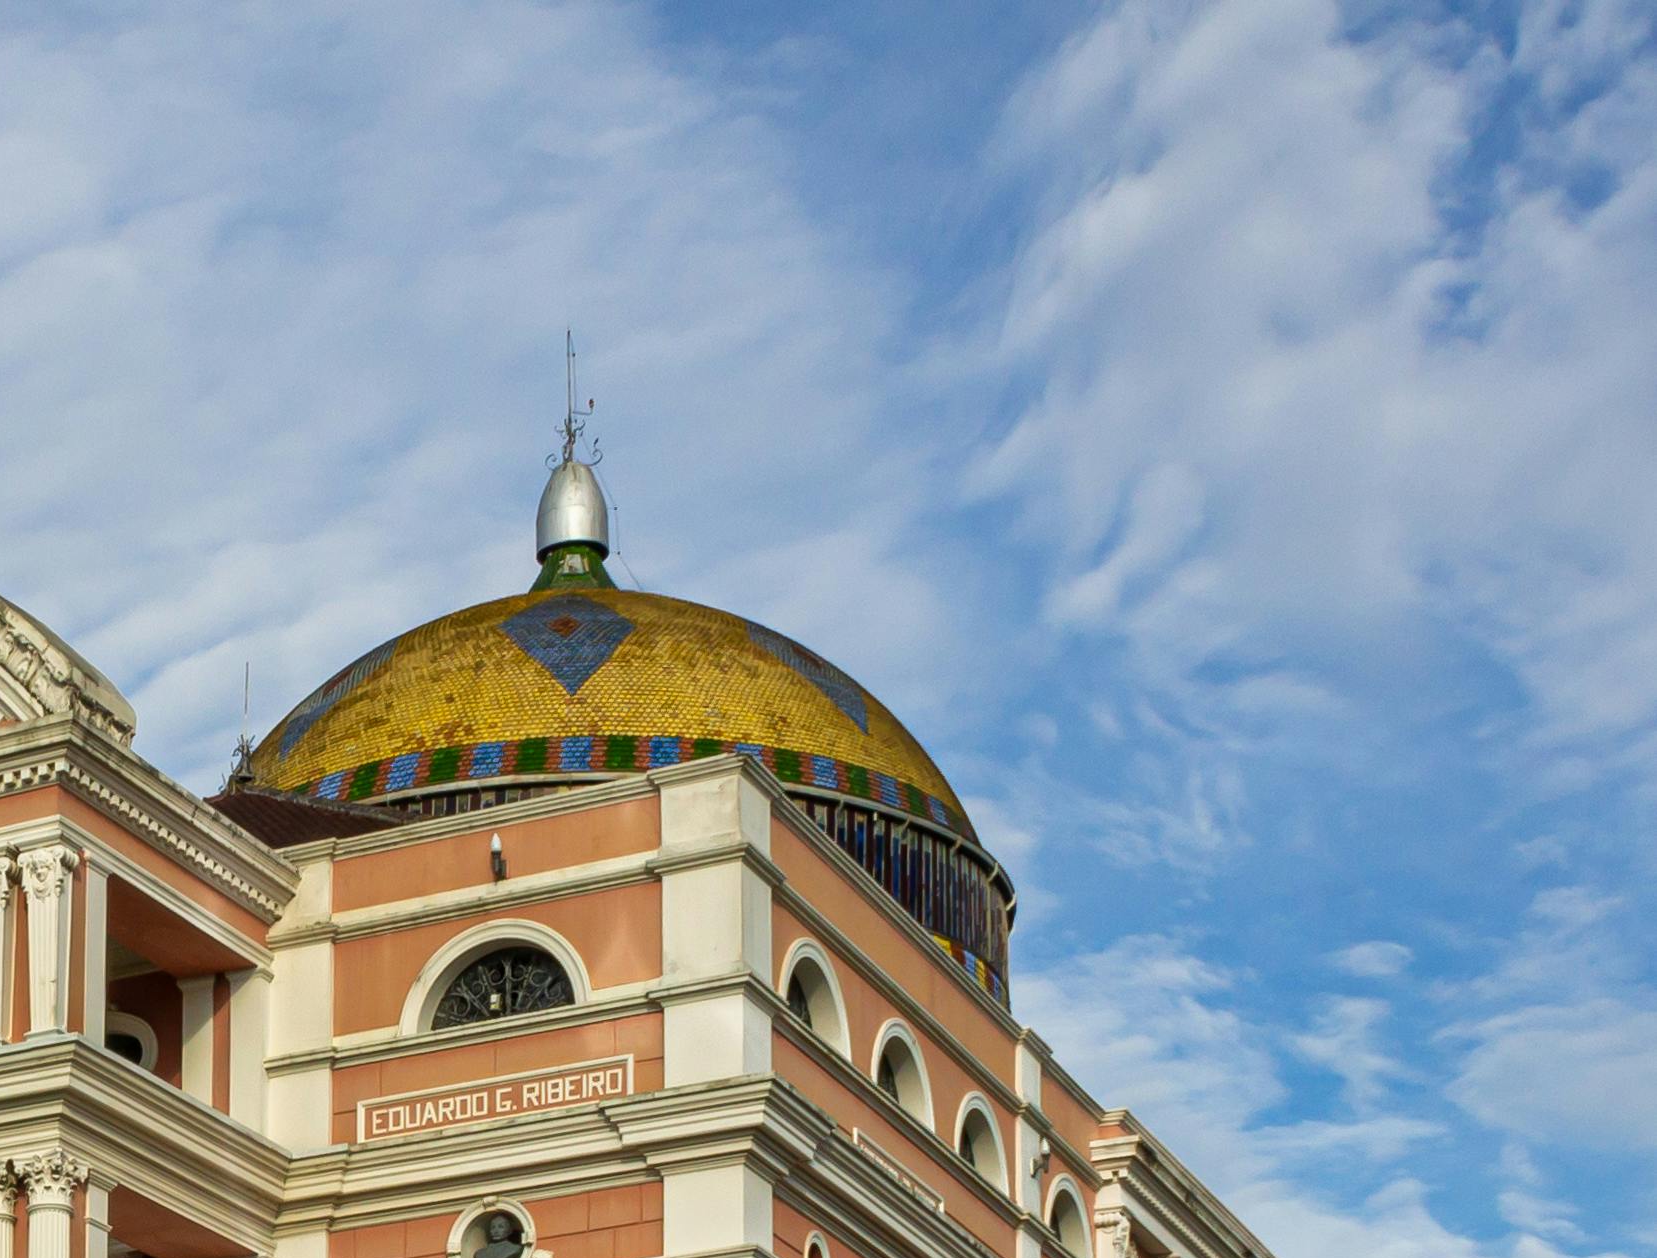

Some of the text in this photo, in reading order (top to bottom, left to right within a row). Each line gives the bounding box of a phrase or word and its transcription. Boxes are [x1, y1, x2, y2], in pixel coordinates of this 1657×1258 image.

[372, 1068, 623, 1135] EDUARDO G. RIBEIRO
